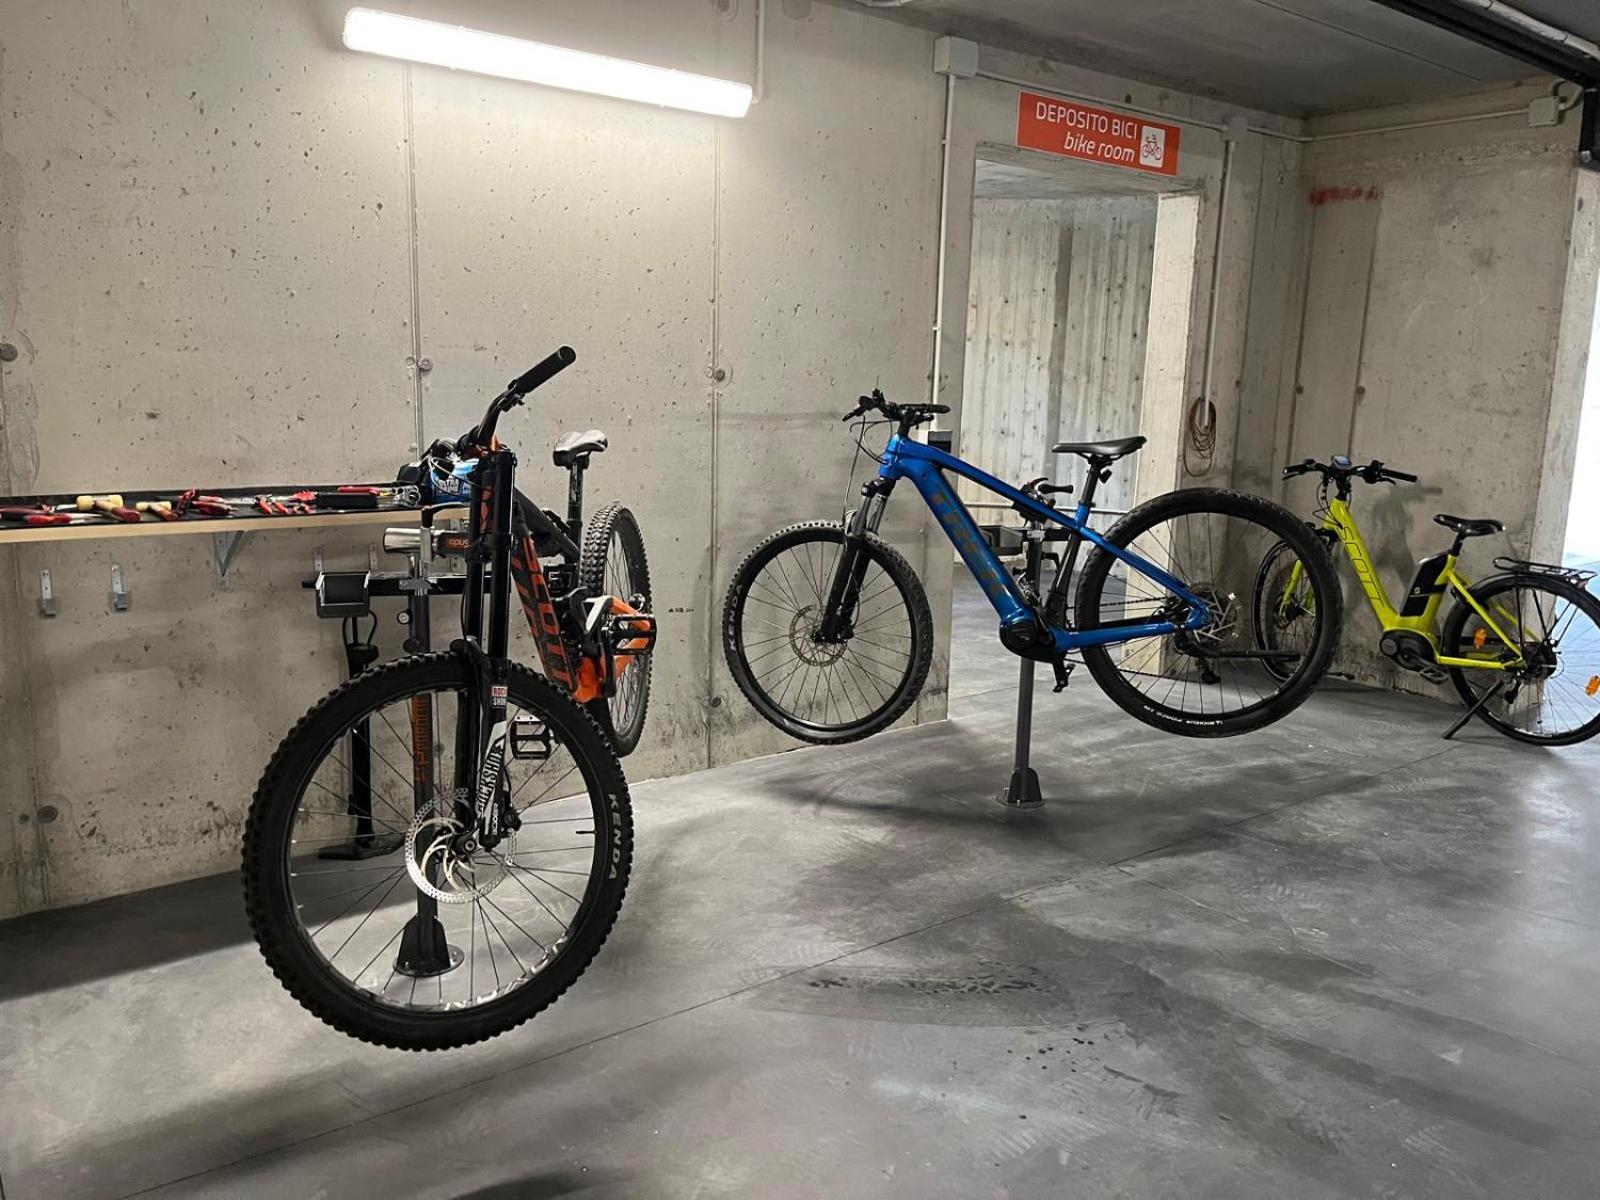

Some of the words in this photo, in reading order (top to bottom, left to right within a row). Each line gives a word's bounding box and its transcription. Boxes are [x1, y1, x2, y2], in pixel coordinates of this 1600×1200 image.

[1036, 101, 1108, 133] DEPOSITO
[1111, 119, 1138, 140] BICI
[1064, 131, 1096, 155] bike
[1097, 142, 1135, 162] room
[1339, 524, 1384, 608] SCOTT
[522, 536, 576, 690] SCOTT
[728, 584, 743, 652] KENDA
[608, 793, 622, 880] KENDA
